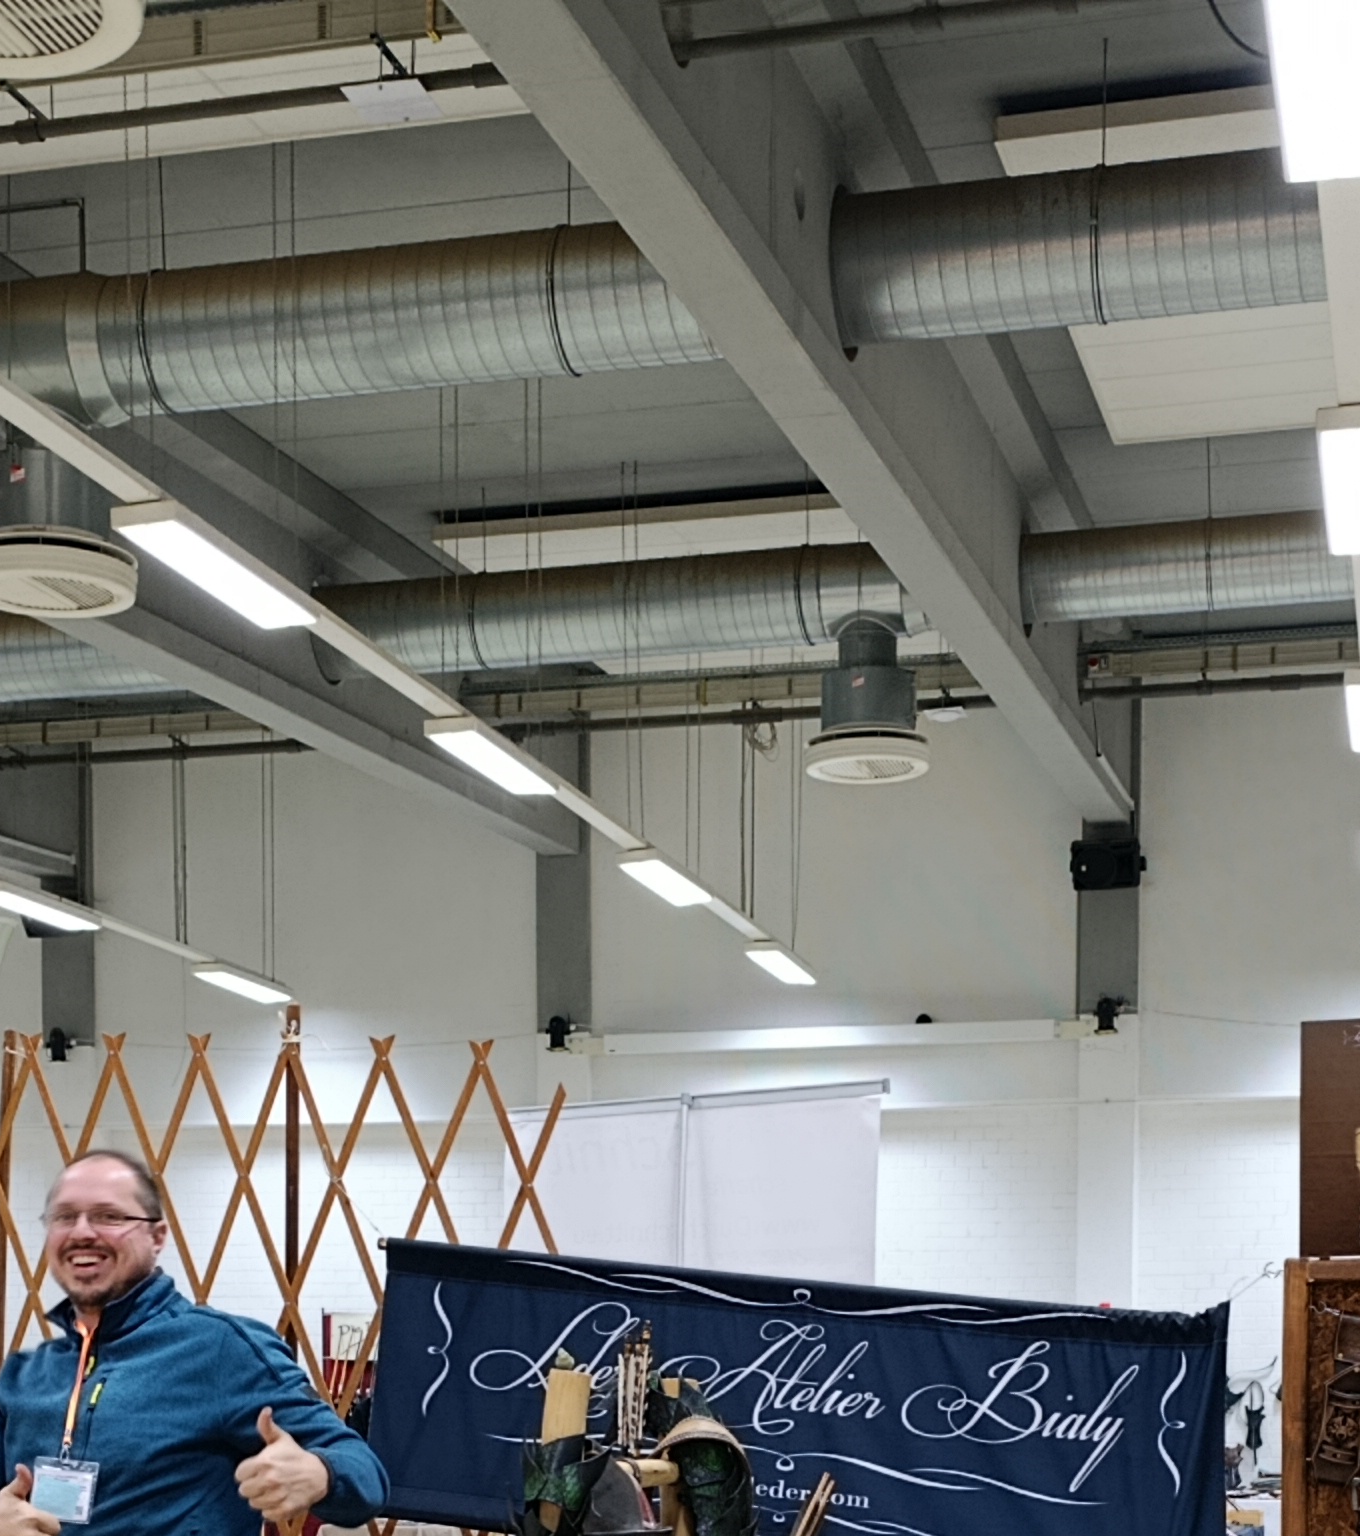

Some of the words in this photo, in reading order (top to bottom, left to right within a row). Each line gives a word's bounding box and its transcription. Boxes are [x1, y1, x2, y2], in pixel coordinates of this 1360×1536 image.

[469, 1301, 640, 1419] Lde
[901, 1340, 1140, 1492] Bialy
[751, 1476, 870, 1509] ederom
